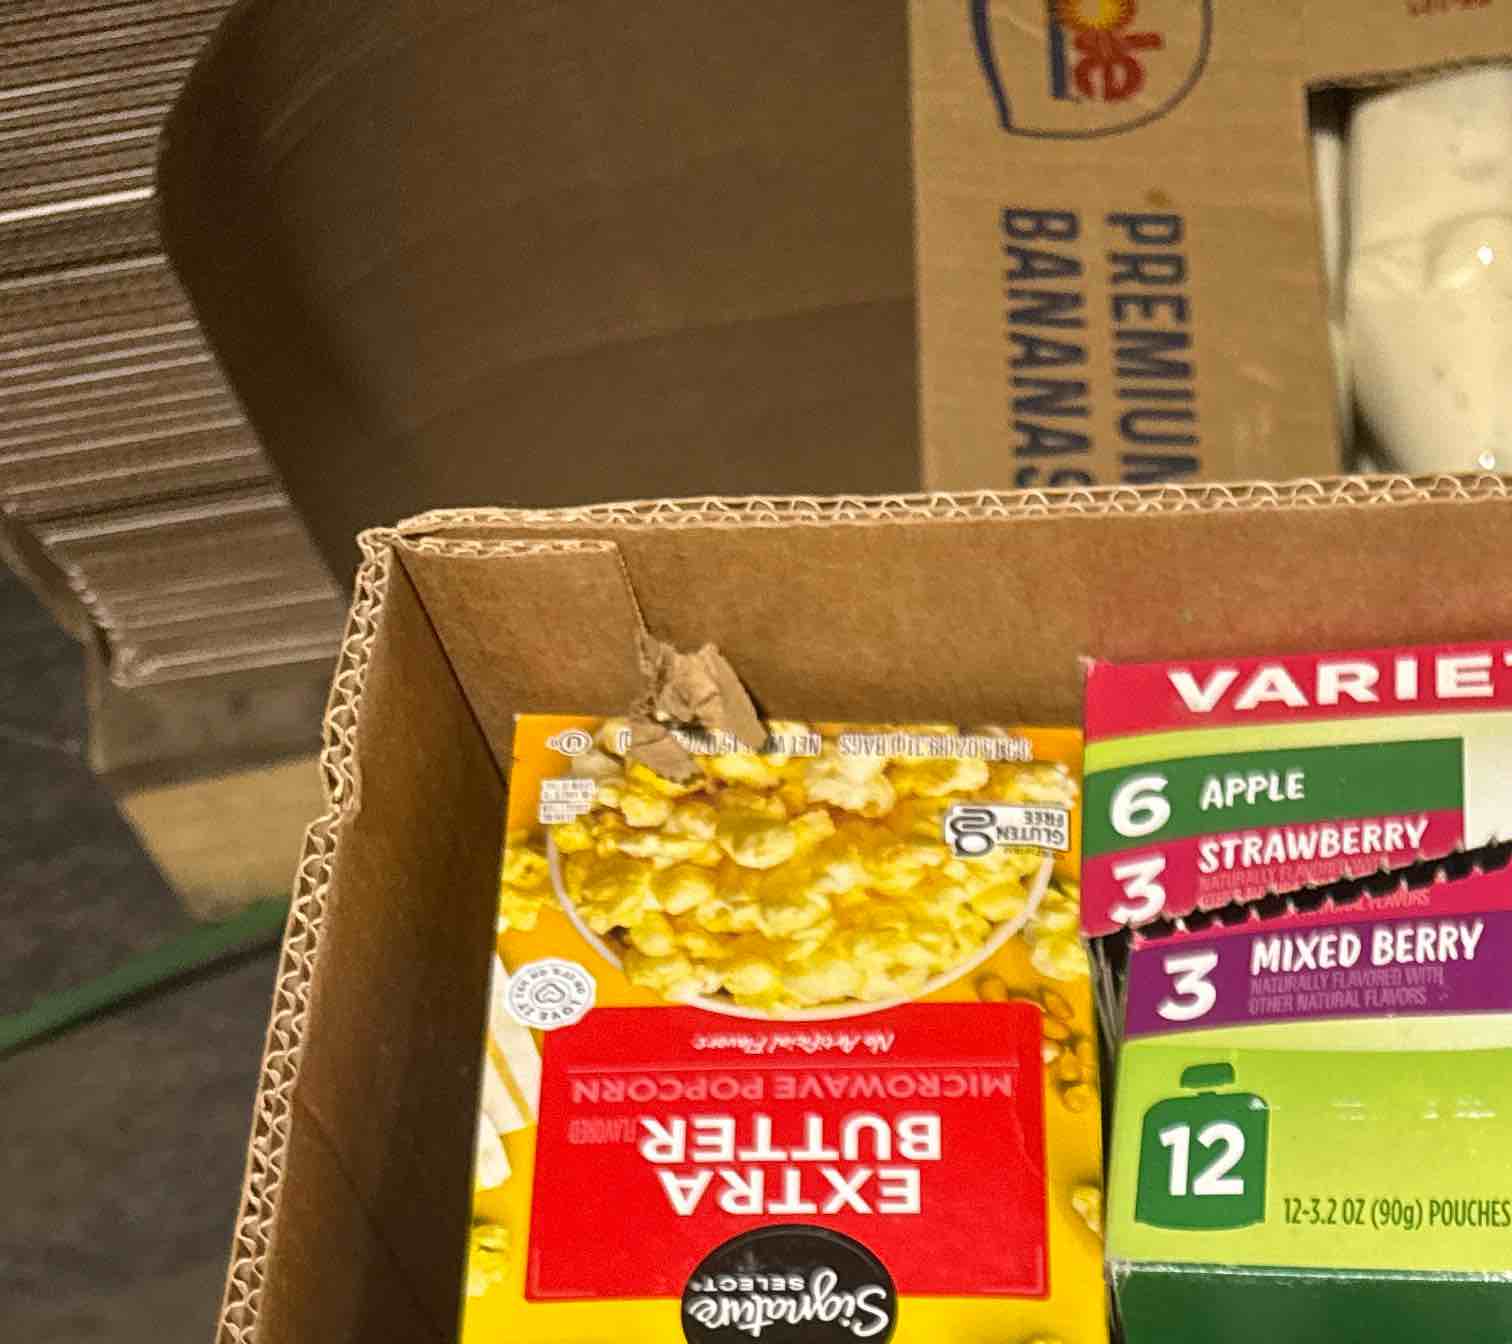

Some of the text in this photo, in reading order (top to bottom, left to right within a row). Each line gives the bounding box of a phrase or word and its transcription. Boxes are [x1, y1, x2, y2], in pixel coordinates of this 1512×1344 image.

[1023, 810, 1066, 828] FREE
[1110, 773, 1306, 837] 6 APPLE
[996, 824, 1066, 845] GLUTEN
[1110, 857, 1167, 925] 3
[1198, 819, 1429, 874] STRAWBERRY
[1158, 920, 1484, 1022] 3 MIXED BERRY
[691, 1032, 768, 1054] Flavors
[861, 1031, 895, 1054] No
[571, 1071, 1013, 1104] POPCORN MICROWAVE
[640, 1114, 944, 1163] BUTTER
[1159, 1122, 1247, 1198] 12
[659, 1167, 922, 1216] EXTRA
[1284, 1198, 1339, 1227] 12-3.2
[1342, 1199, 1367, 1227] OZ
[1370, 1199, 1425, 1232] (90g)
[1429, 1199, 1512, 1229] POUCHES
[689, 1267, 888, 1338] Signature
[695, 1276, 805, 1293] SELECT
